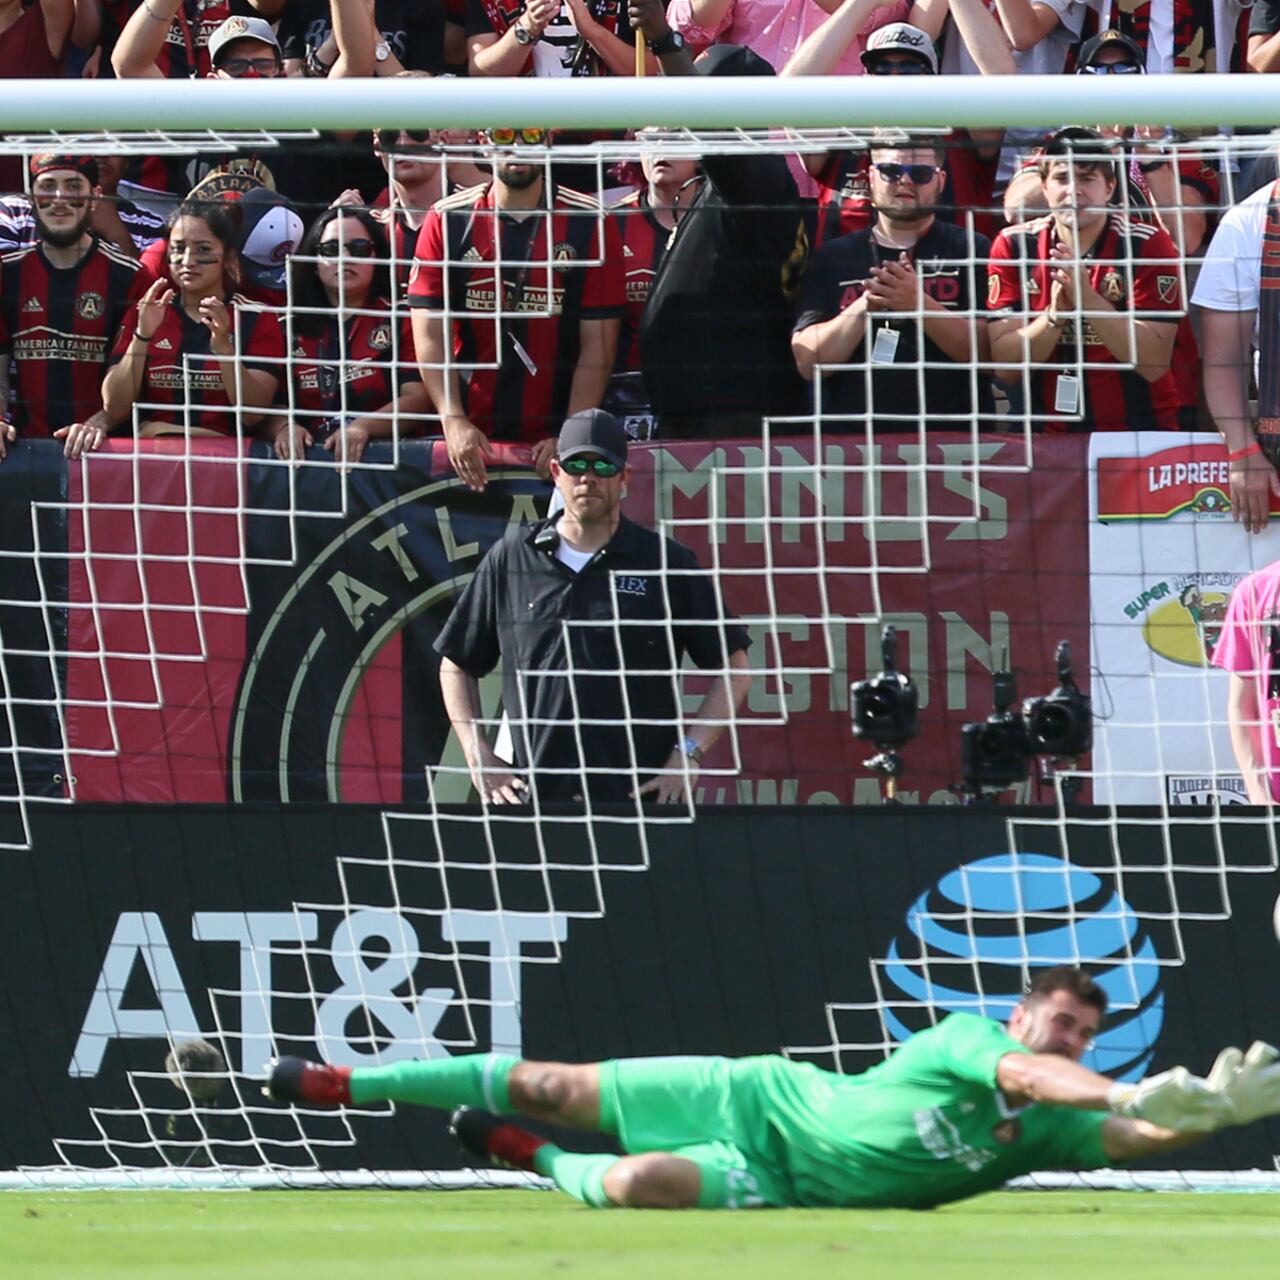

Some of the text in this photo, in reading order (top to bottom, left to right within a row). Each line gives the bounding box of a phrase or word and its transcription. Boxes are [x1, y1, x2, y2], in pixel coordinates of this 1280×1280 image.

[874, 31, 924, 48] United
[523, 291, 563, 304] FAMLY
[14, 339, 107, 352] AMERICAN FAMILY
[150, 372, 190, 381] AMERICAN
[648, 441, 1009, 544] MINUS
[1149, 462, 1228, 493] LA PREFE
[327, 494, 542, 632] ATLA
[1123, 582, 1171, 620] SUPER
[679, 610, 1011, 713] GION
[67, 910, 568, 1079] AT&T
